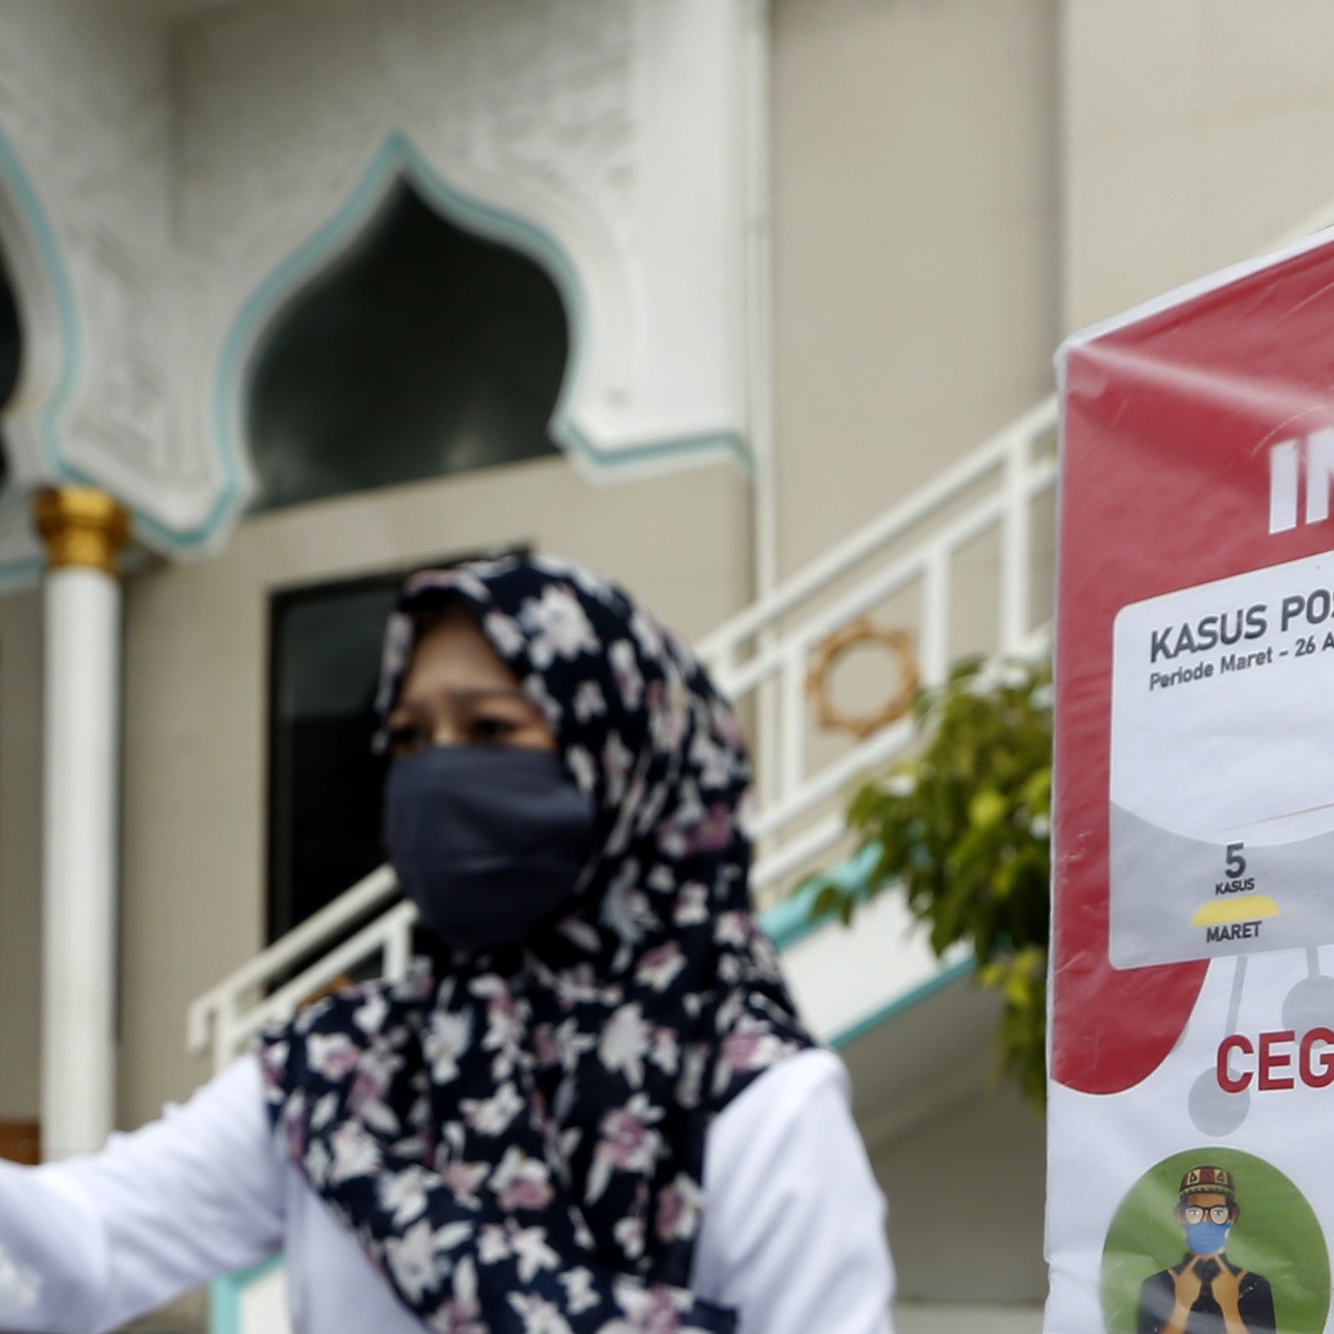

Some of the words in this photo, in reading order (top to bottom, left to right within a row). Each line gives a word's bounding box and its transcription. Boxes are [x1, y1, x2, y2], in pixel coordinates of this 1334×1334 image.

[1150, 605, 1268, 663] KASUS
[1149, 657, 1214, 691] Periode
[1221, 646, 1273, 675] Maret
[1296, 636, 1316, 658] 26
[1225, 843, 1246, 880] 5
[1215, 877, 1255, 895] KASUS
[1206, 922, 1262, 943] MARET
